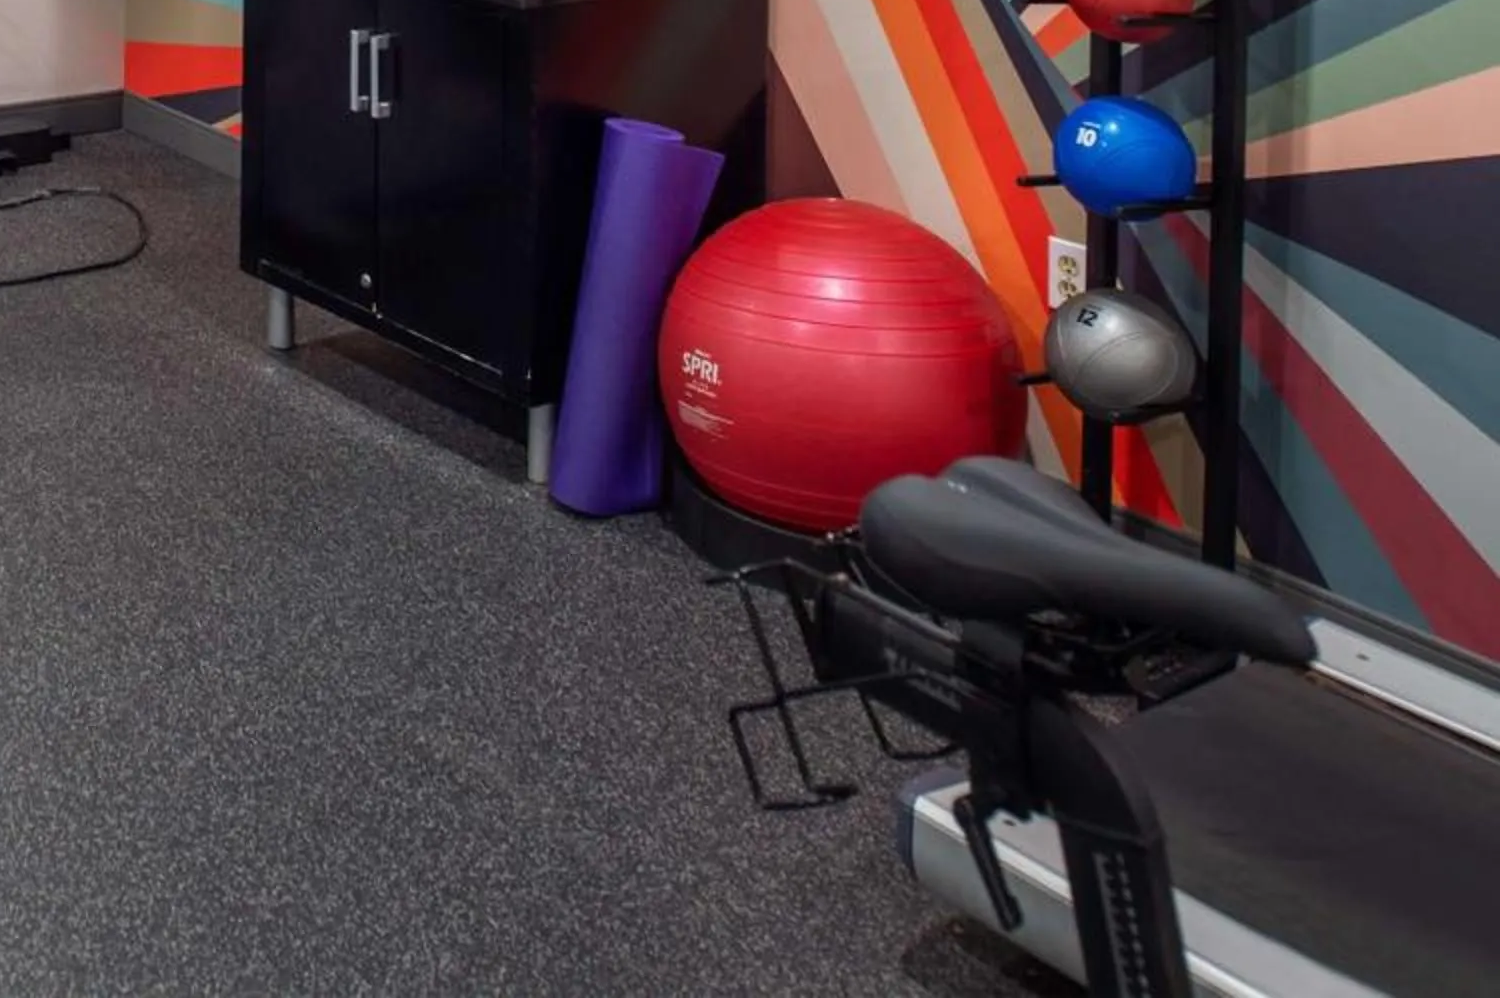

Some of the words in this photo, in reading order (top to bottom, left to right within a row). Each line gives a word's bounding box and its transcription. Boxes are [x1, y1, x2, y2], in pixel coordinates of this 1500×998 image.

[1075, 127, 1097, 147] 10
[1076, 308, 1099, 327] 12
[682, 351, 719, 384] SPRI
